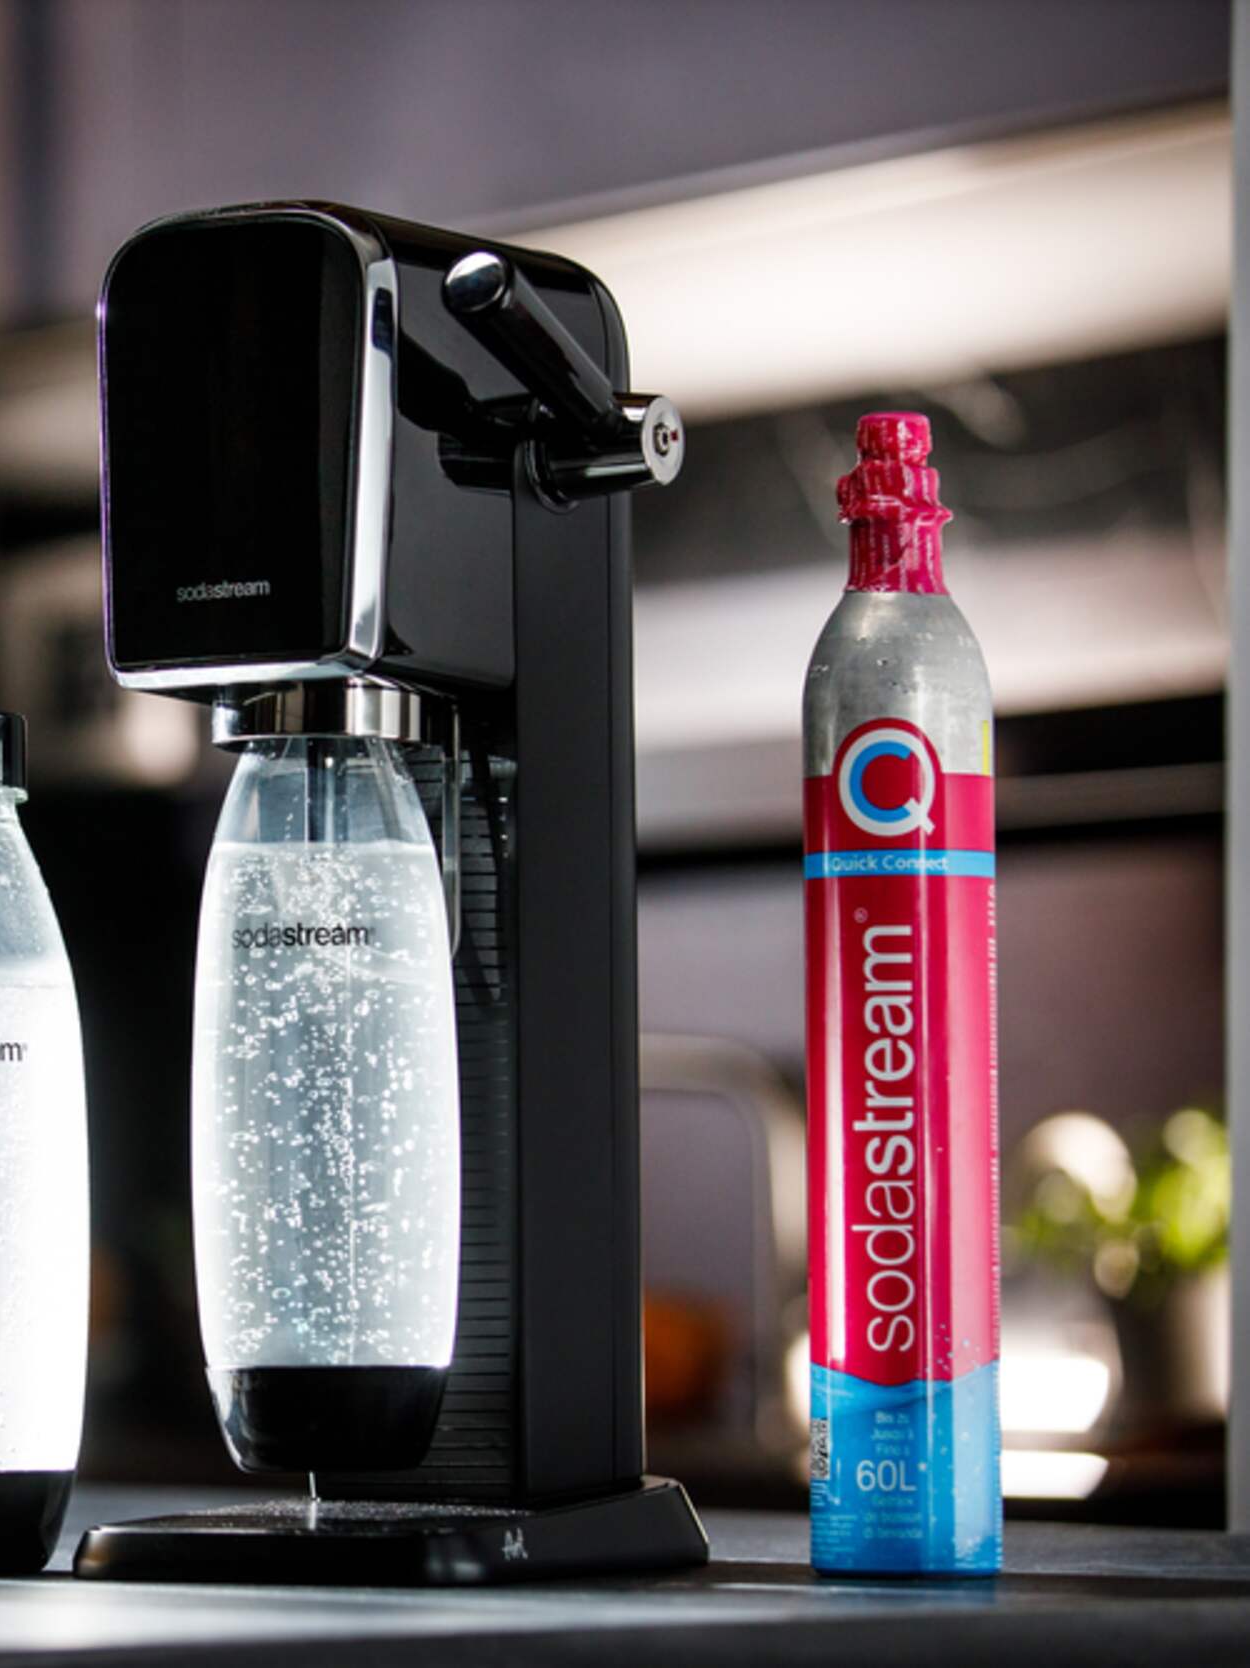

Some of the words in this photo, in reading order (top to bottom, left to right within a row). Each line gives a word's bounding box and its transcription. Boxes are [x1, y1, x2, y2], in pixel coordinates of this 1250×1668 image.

[176, 579, 271, 602] sodastream
[832, 855, 878, 873] Quick
[232, 922, 370, 949] sodastream
